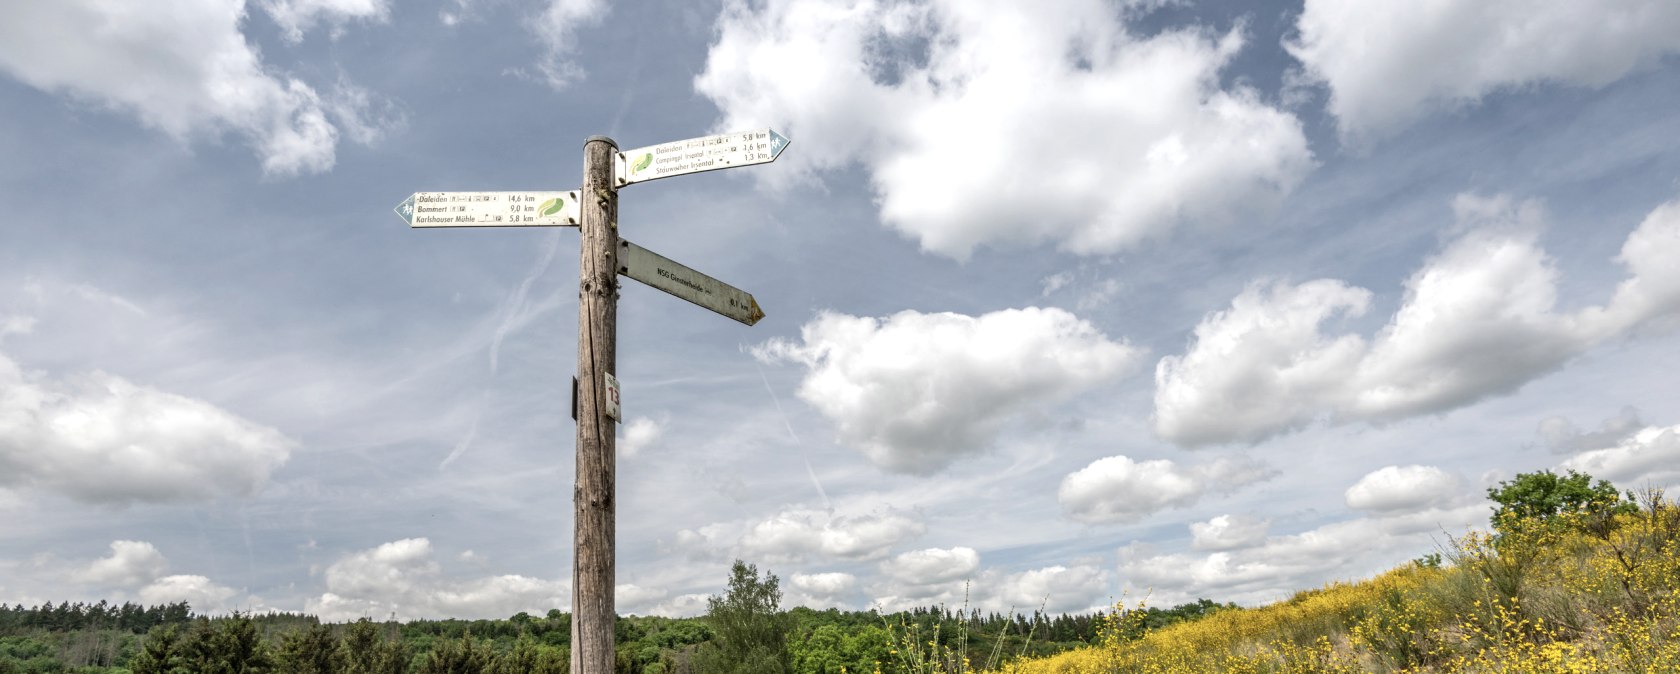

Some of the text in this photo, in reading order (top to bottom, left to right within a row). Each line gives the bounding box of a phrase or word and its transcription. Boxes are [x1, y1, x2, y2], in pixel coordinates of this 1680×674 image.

[655, 145, 682, 154] Daleiden
[691, 159, 714, 168] Irsental
[419, 195, 448, 203] Daleiden
[418, 205, 447, 213] Bommert
[510, 205, 521, 213] 9,0
[657, 267, 670, 279] NSG
[741, 302, 749, 312] km
[608, 386, 620, 406] 13
